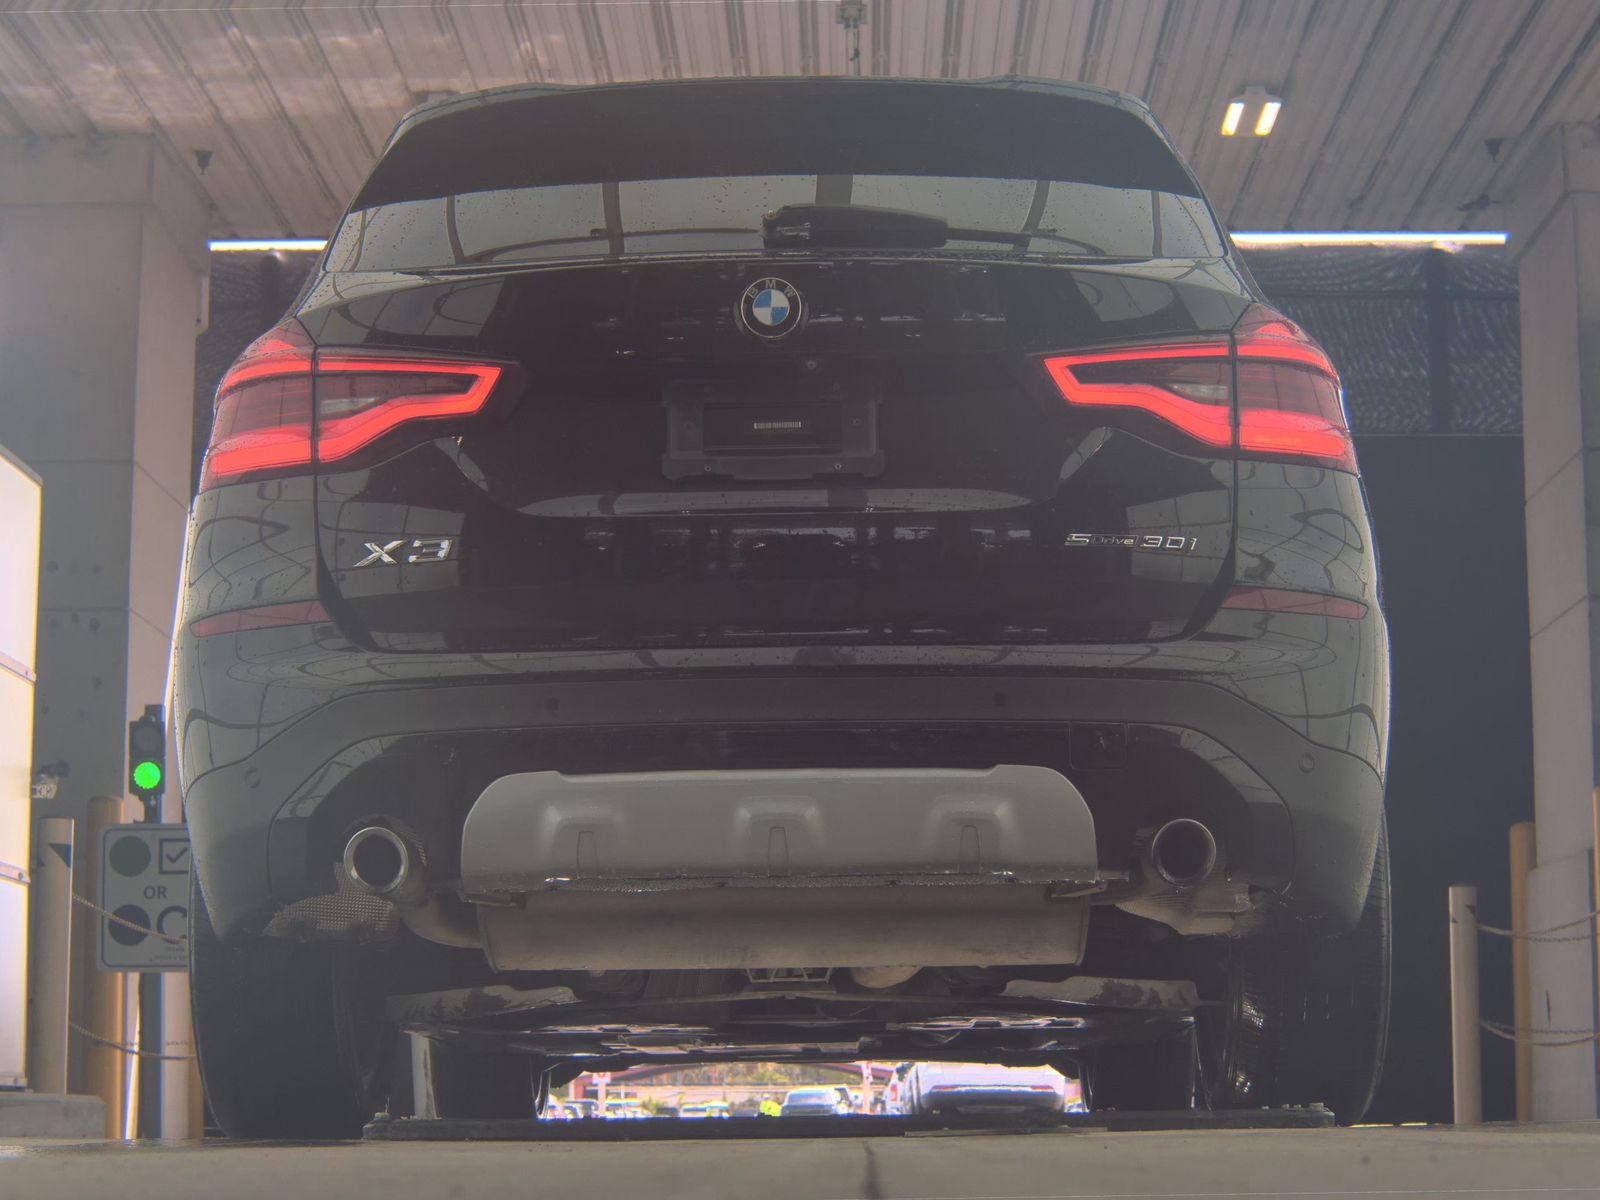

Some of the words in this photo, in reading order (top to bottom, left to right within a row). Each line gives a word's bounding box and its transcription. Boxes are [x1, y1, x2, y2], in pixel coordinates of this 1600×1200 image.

[747, 279, 796, 298] BMW
[353, 538, 452, 567] X3
[143, 885, 166, 899] OR
